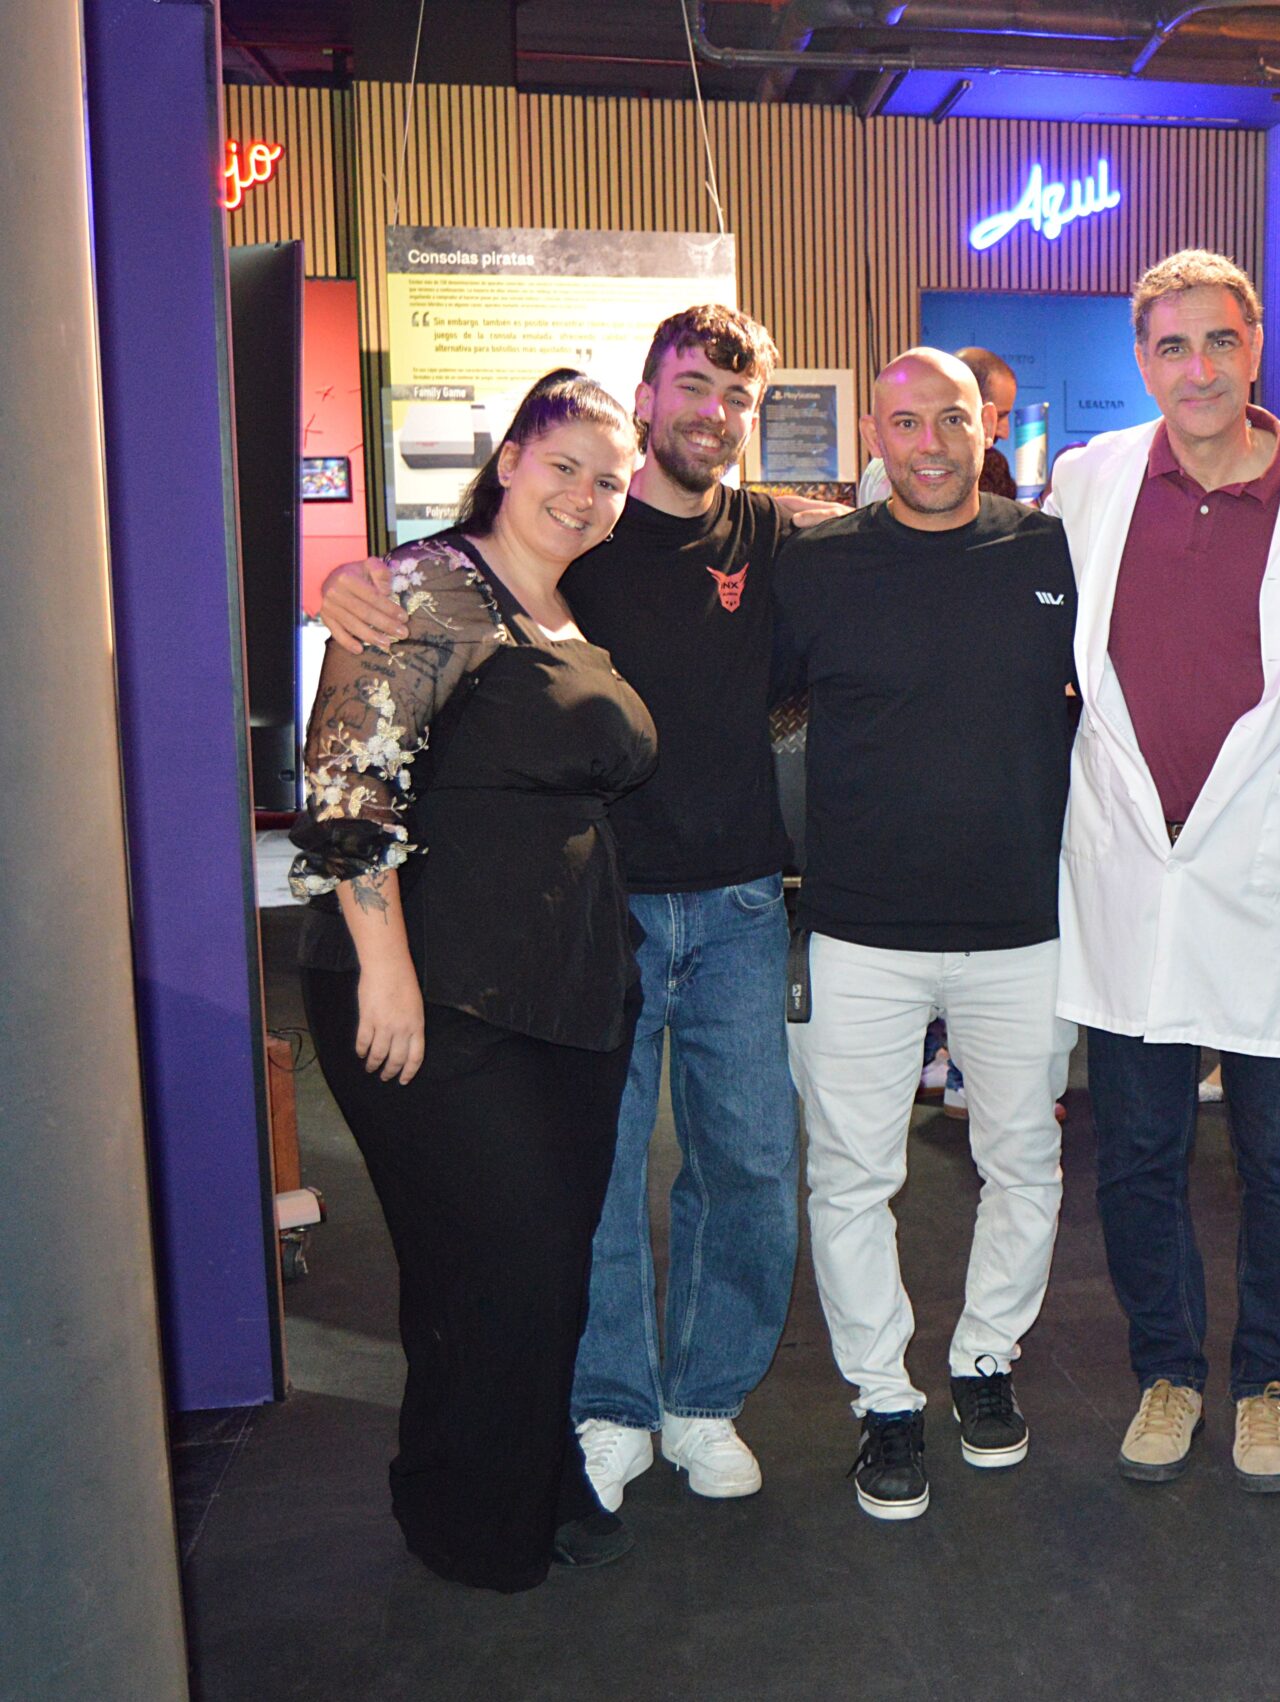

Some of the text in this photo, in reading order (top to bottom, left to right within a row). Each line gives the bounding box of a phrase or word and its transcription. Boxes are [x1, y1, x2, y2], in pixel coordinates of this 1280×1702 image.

[224, 142, 281, 208] jo
[970, 159, 1121, 250] Azul
[408, 249, 535, 268] Consolas piratas
[414, 387, 466, 399] Family Game
